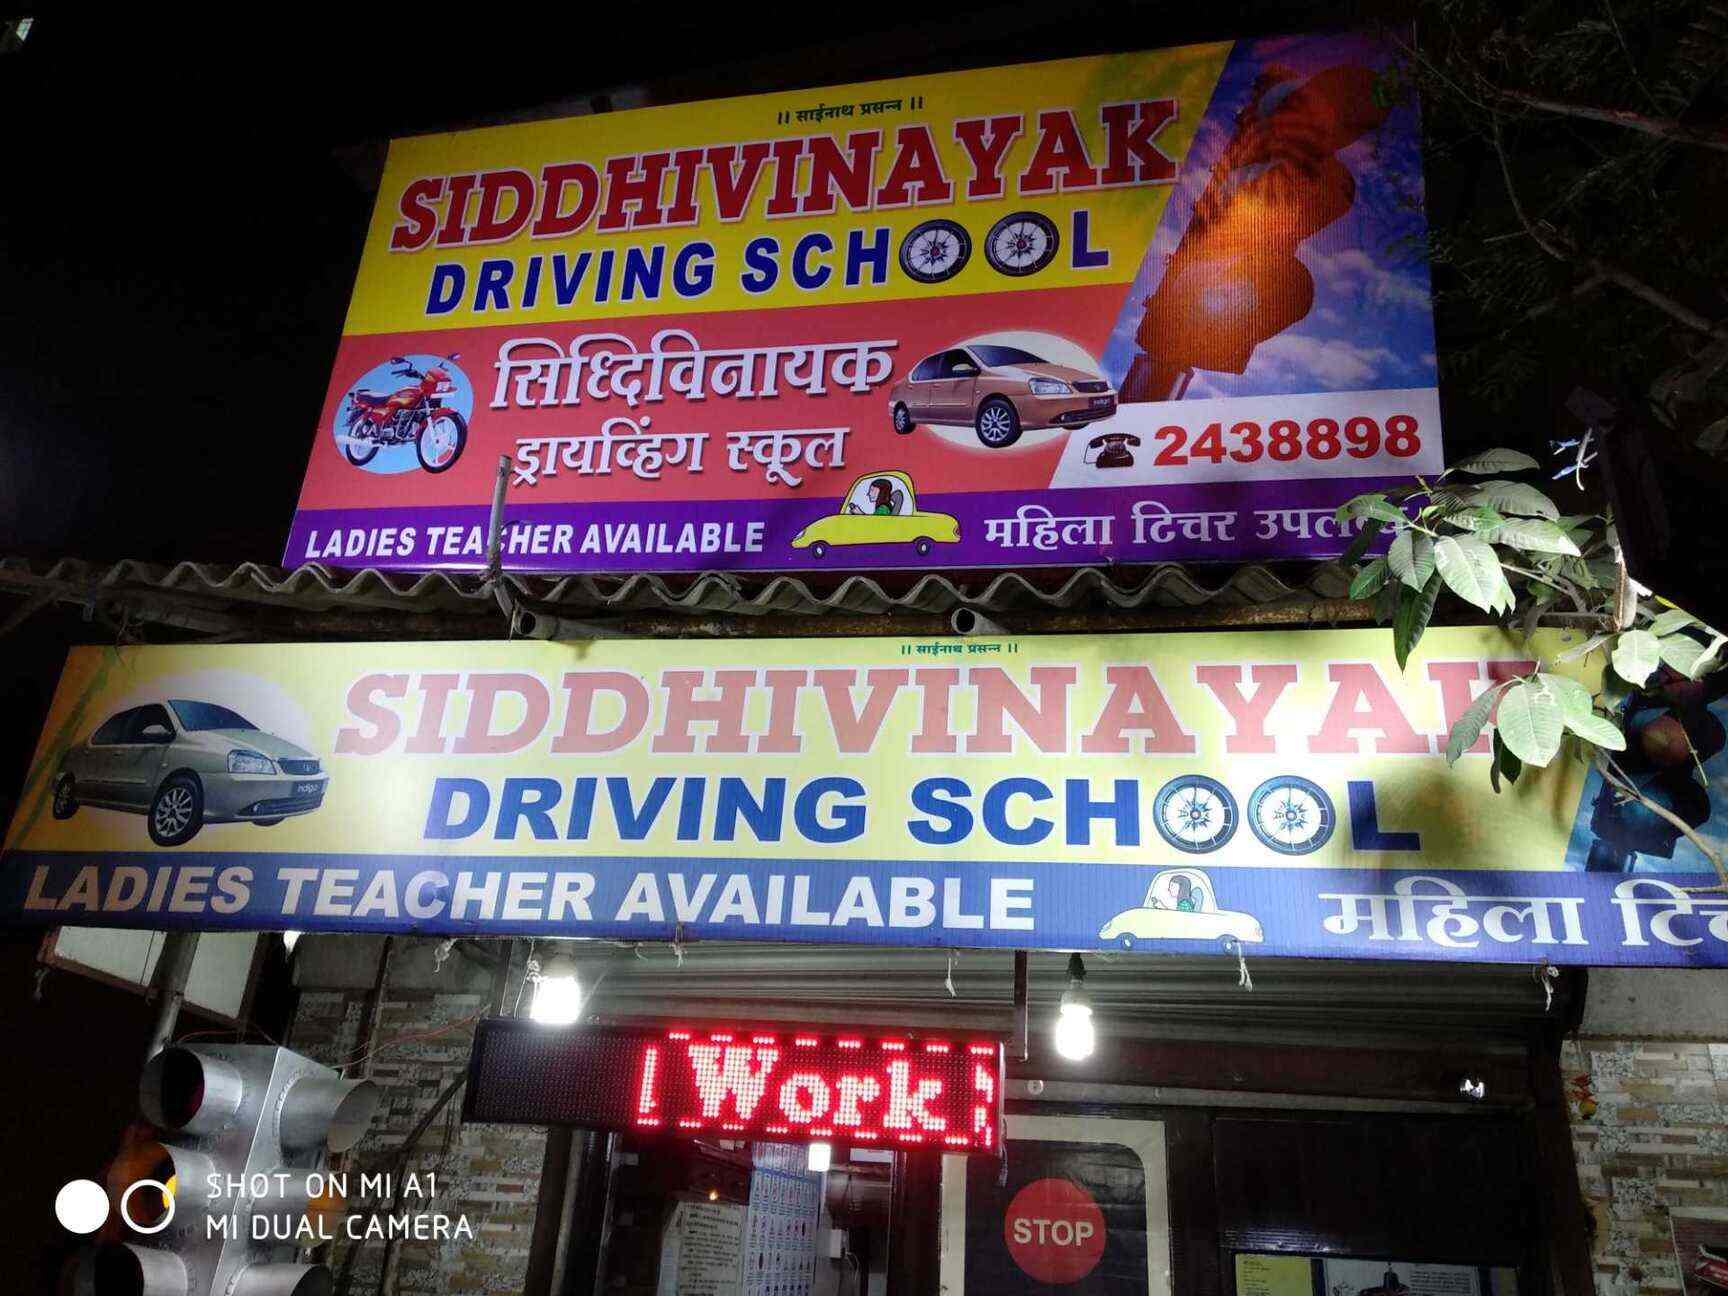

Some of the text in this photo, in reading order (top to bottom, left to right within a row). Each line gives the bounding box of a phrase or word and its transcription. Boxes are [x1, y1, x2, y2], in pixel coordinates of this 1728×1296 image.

[796, 102, 855, 122] साईनाथ
[391, 97, 1179, 252] SIDDHIVINAYAK
[425, 240, 715, 316] DRIVING
[726, 427, 851, 487] स्कूल
[1153, 415, 1421, 467] 2438898
[305, 527, 416, 559] LADIES
[579, 521, 766, 554] AVAILABLE
[984, 504, 1113, 551] महिला
[1131, 501, 1238, 542] टिचर
[423, 776, 868, 844] DRIVING
[23, 865, 1036, 932] LADIES TEACHER AVAILABLE
[1318, 875, 1589, 949] महिला
[686, 1044, 946, 1132] Work
[1013, 1217, 1095, 1247] STOP
